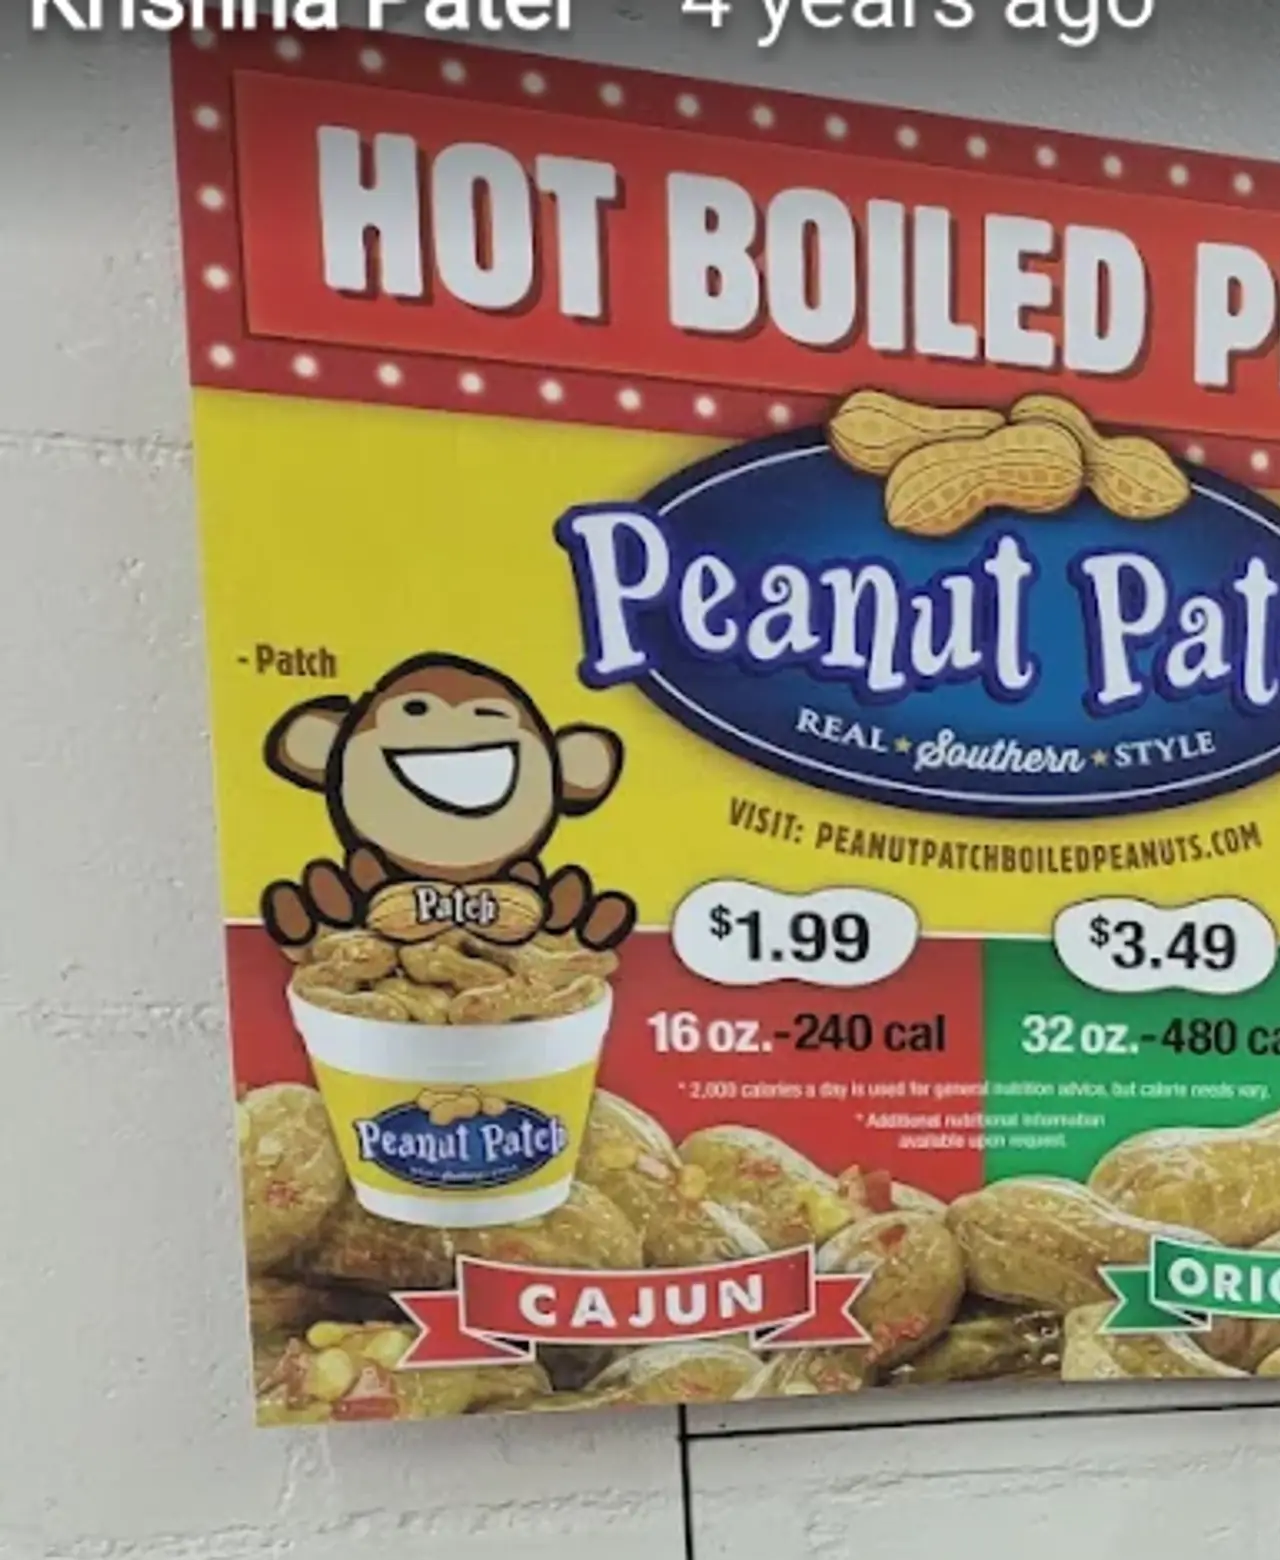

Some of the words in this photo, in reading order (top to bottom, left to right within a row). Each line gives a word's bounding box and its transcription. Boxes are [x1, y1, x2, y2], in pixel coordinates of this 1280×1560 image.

[316, 126, 617, 319] HOT
[666, 172, 1146, 373] BOILED
[571, 513, 1032, 692] Peanut
[256, 645, 337, 679] Patch
[798, 706, 889, 754] REAL
[914, 731, 1085, 774] Southern
[1115, 732, 1215, 768] STYLE
[730, 797, 803, 843] VISIT:
[416, 888, 499, 924] Patch
[709, 904, 871, 962] $1.99
[1089, 915, 1238, 970] $3.49
[647, 1013, 699, 1051] 16
[884, 1013, 946, 1052] cal
[1022, 1016, 1075, 1053] 32
[357, 1120, 470, 1163] Peanut
[481, 1118, 567, 1162] Patch
[518, 1272, 765, 1329] CAJUN
